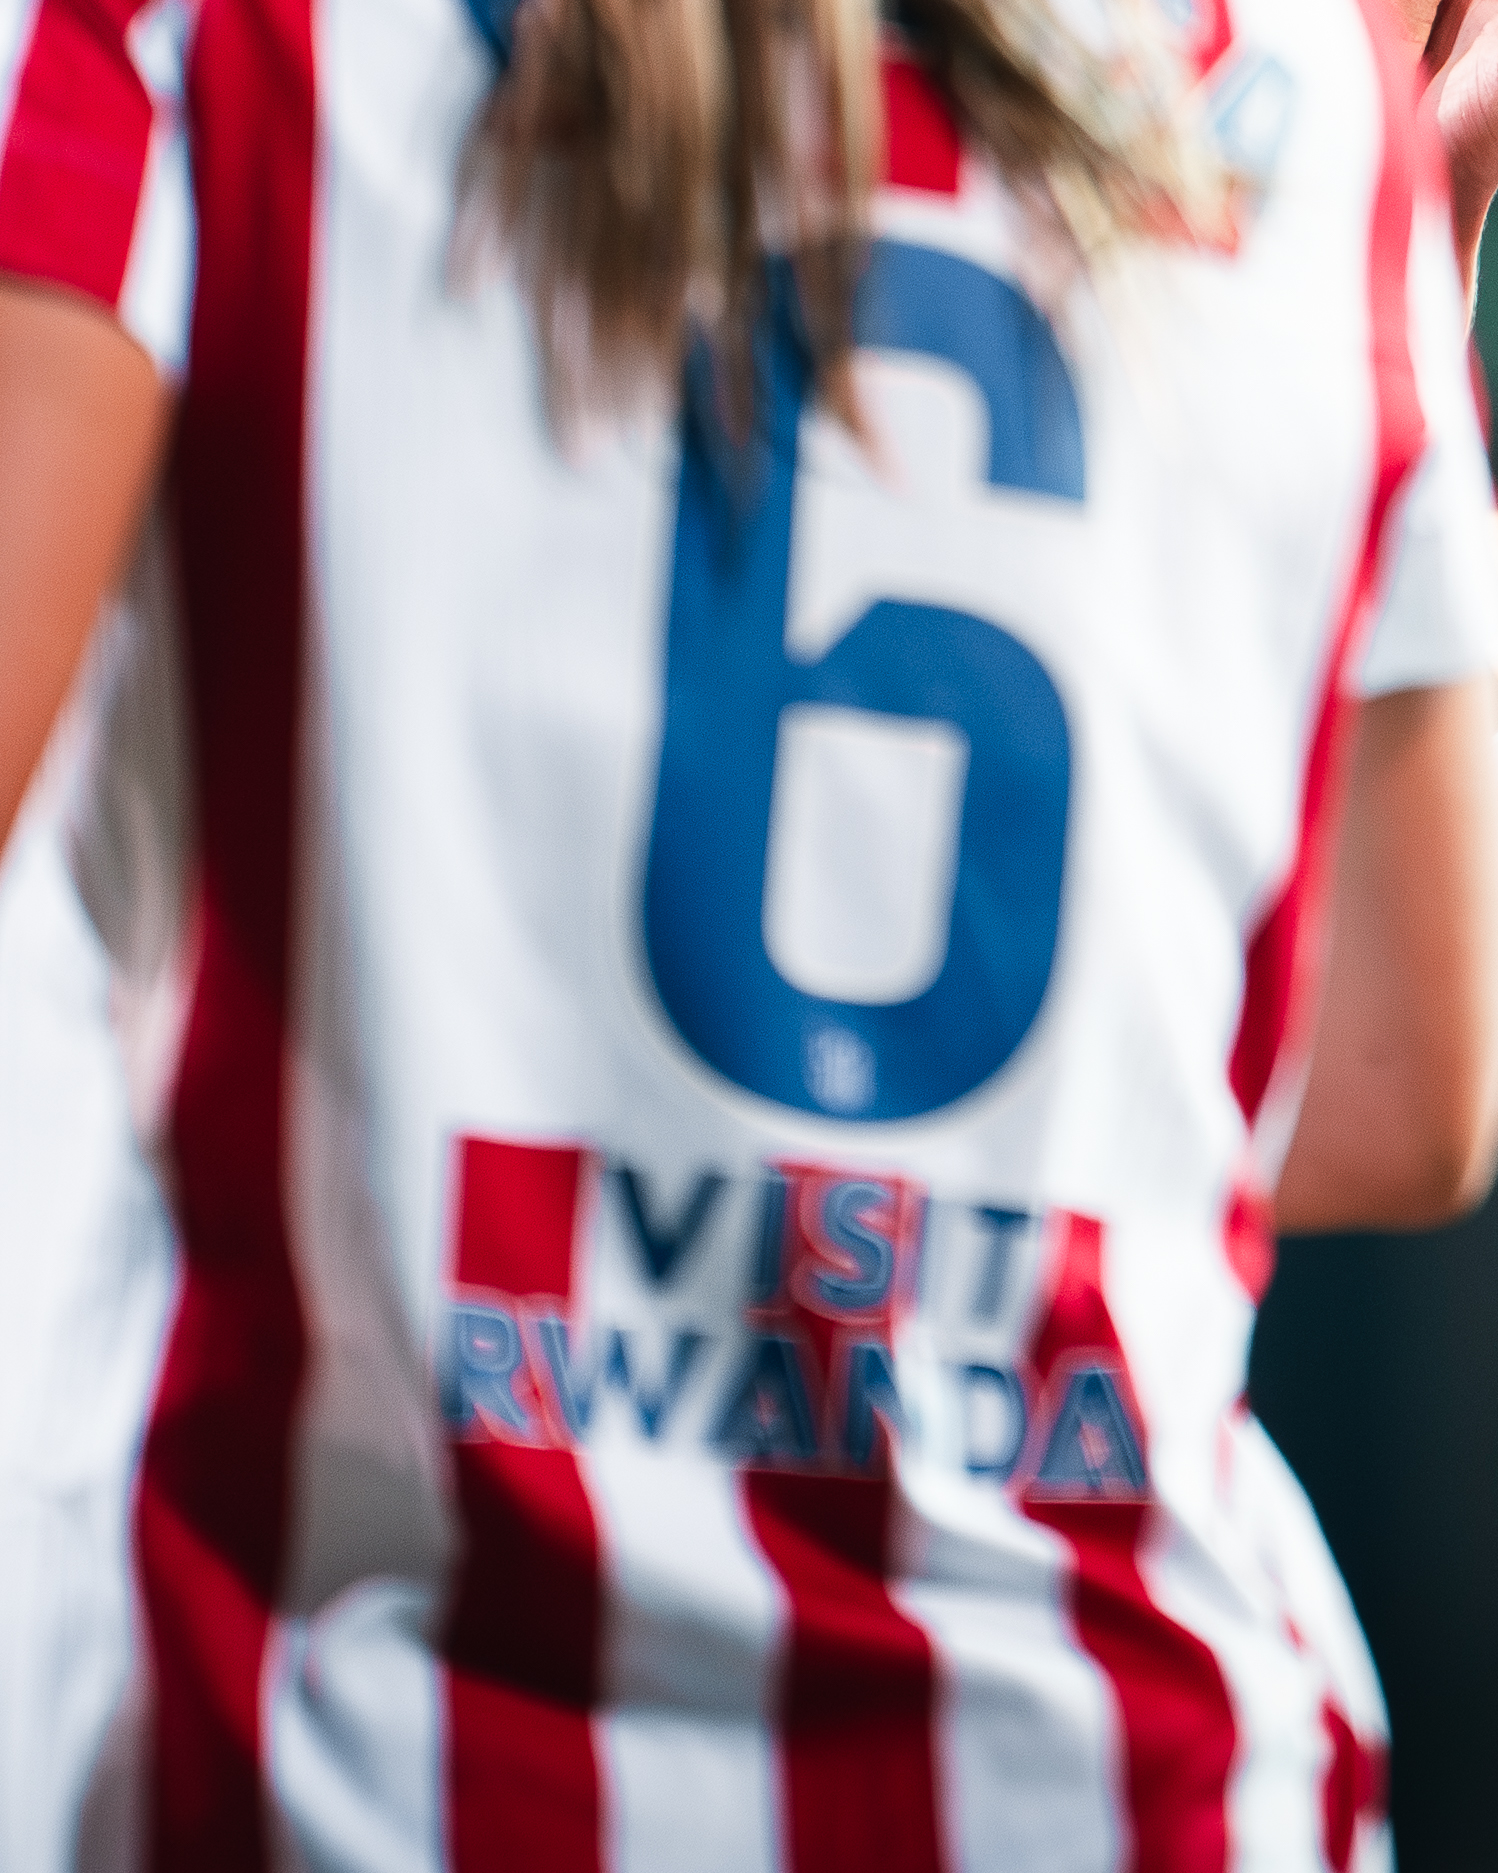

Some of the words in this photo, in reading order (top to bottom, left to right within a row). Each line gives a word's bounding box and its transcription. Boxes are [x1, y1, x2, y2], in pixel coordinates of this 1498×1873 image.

[642, 236, 1087, 1122] 6
[603, 1164, 1040, 1330] VISIT
[440, 1302, 1150, 1492] RWANDA
